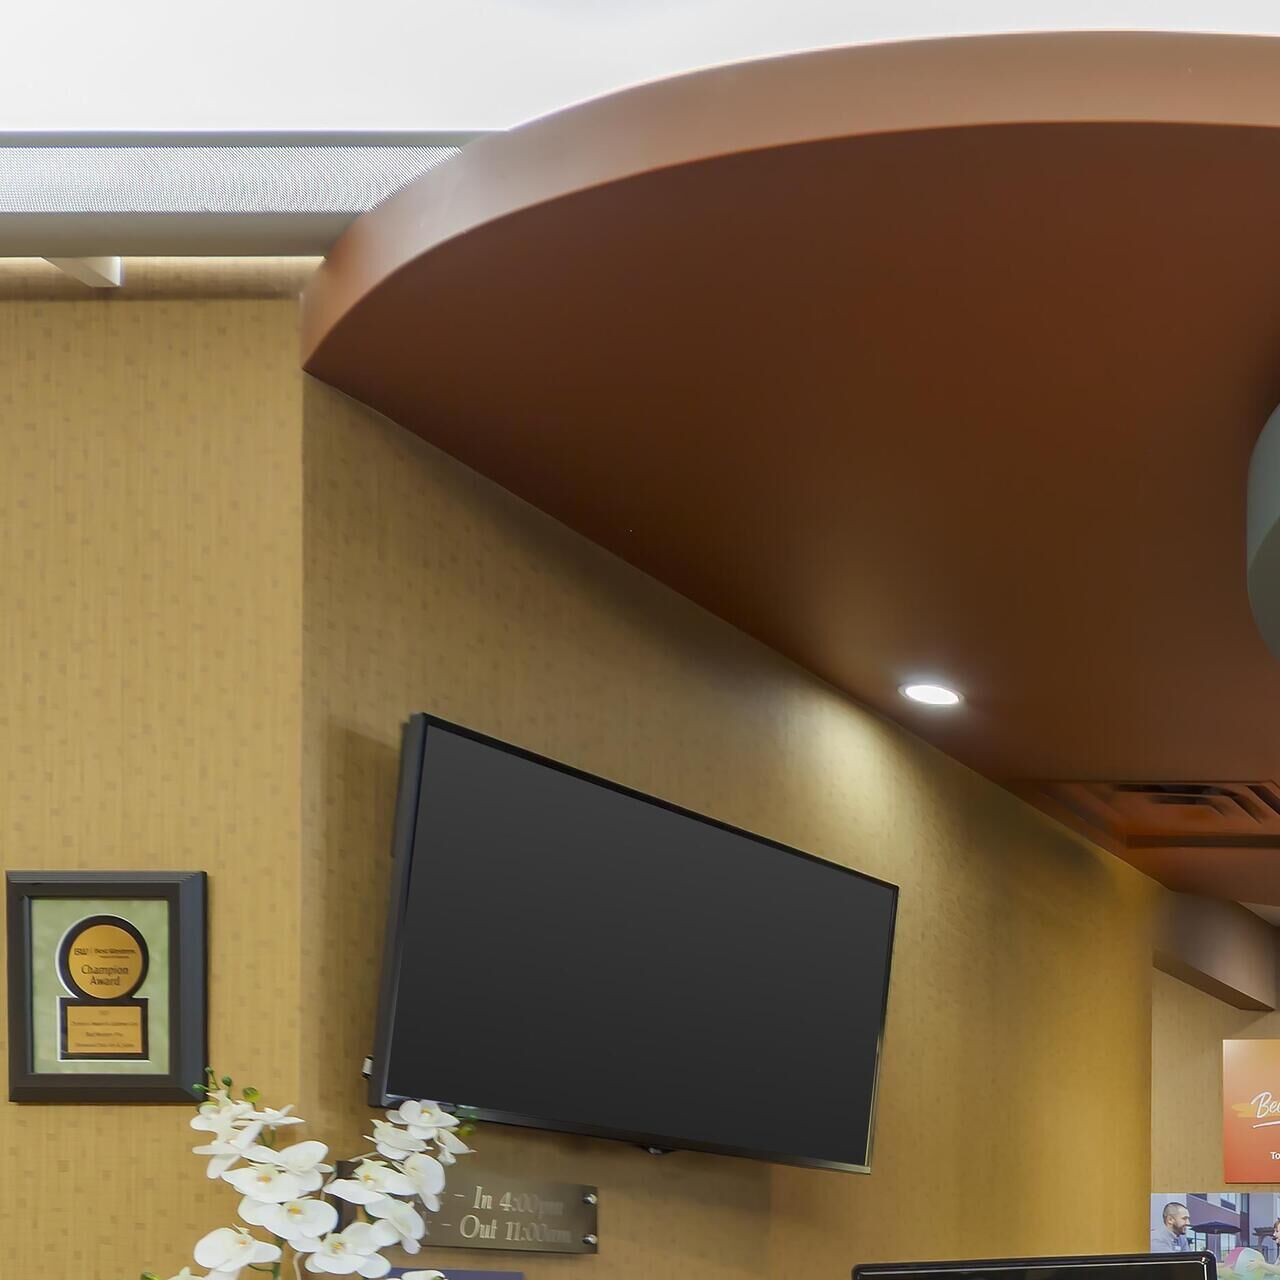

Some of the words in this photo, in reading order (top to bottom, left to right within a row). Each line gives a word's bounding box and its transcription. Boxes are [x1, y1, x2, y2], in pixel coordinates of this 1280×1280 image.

[81, 964, 128, 976] Champion
[90, 976, 120, 986] Award
[1270, 1151, 1280, 1160] To
[473, 1185, 493, 1210] In
[459, 1214, 498, 1239] Out
